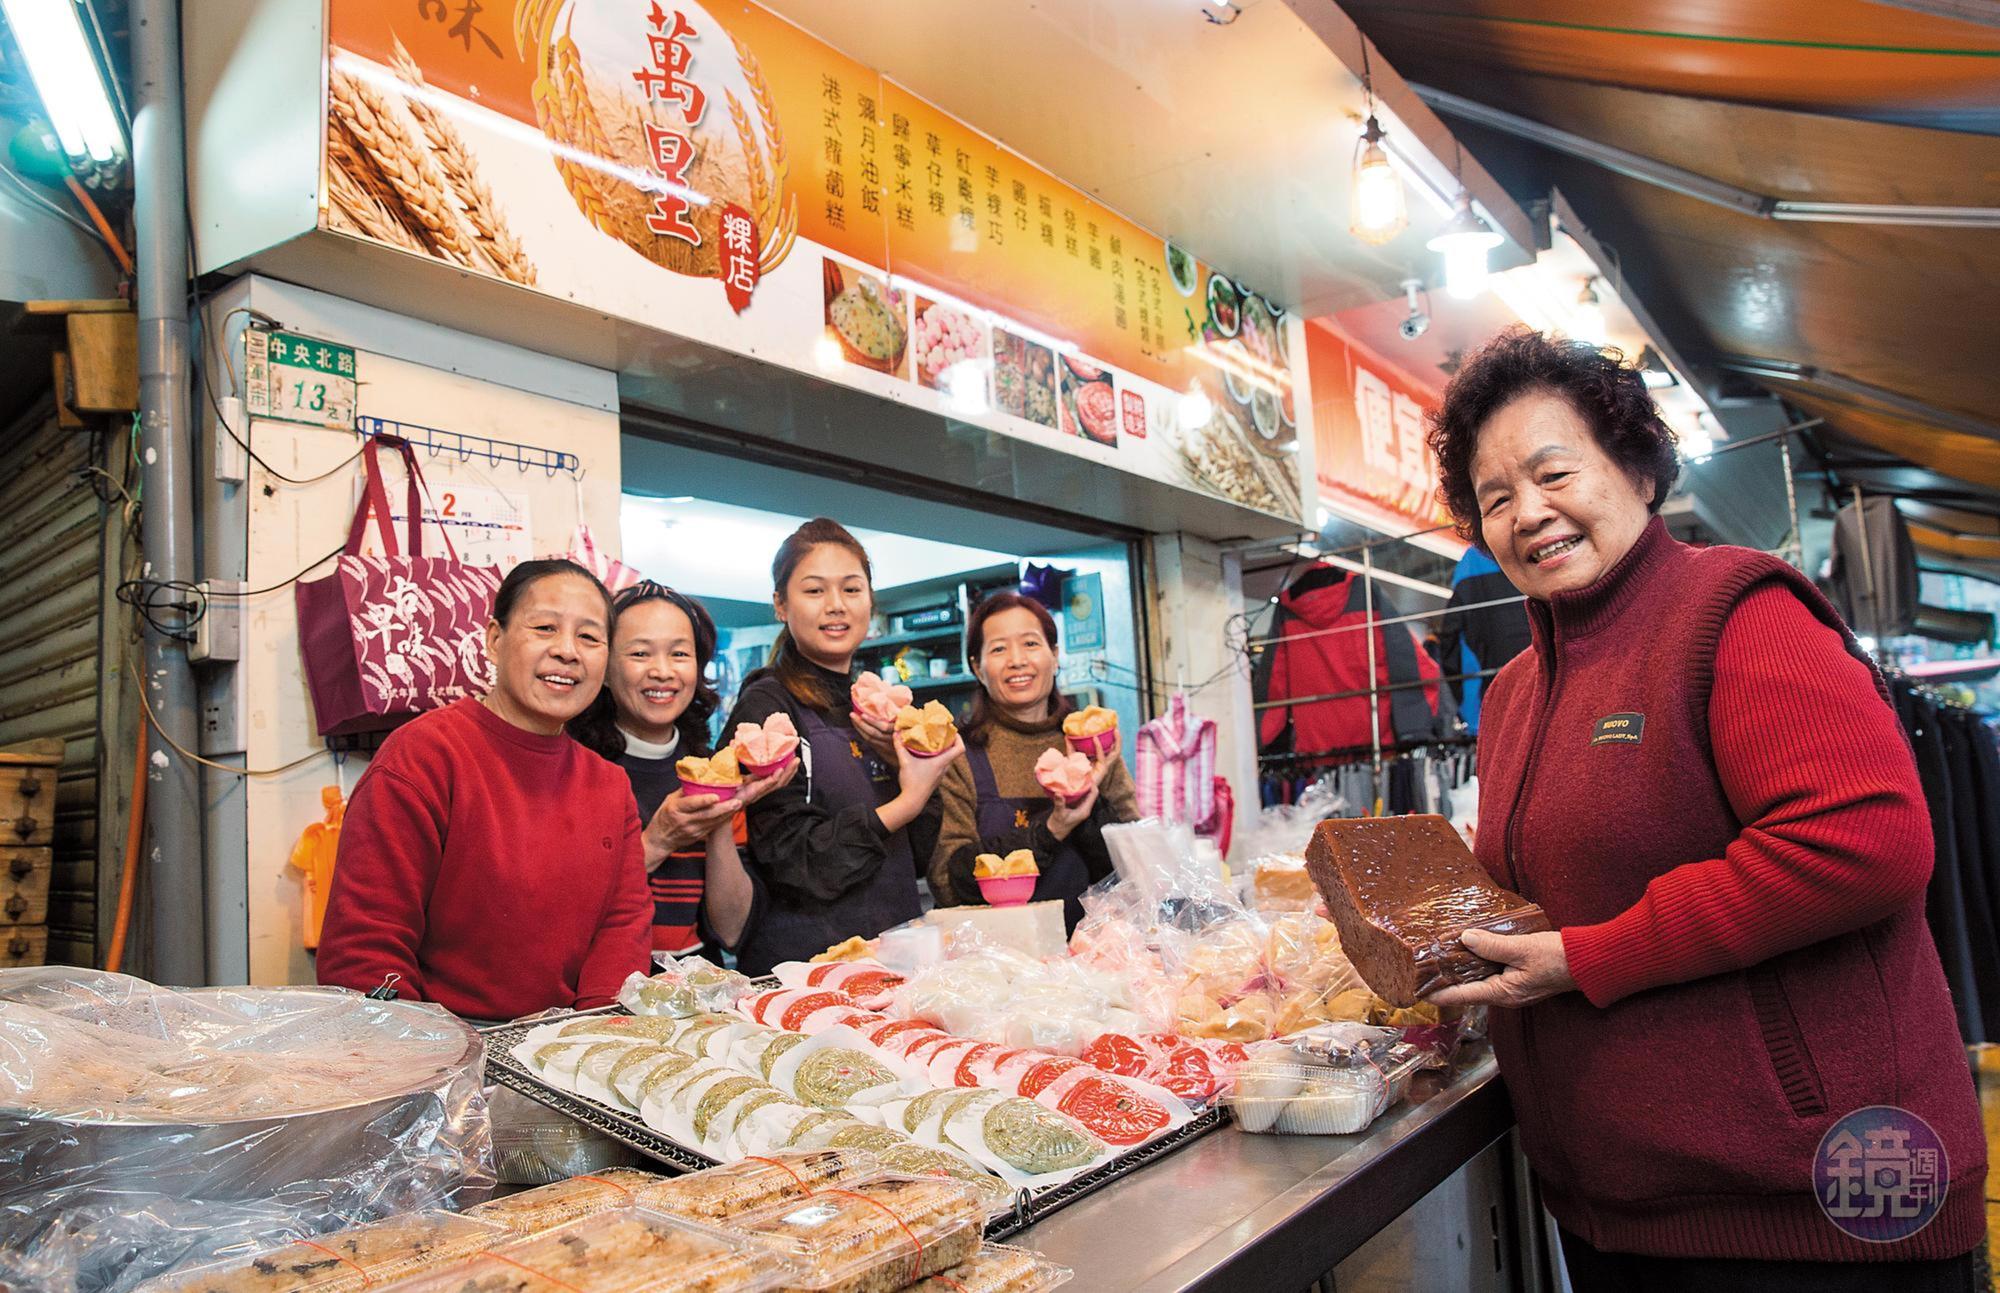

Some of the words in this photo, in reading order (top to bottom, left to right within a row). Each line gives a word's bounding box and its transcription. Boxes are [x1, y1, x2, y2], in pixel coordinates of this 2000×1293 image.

[632, 0, 706, 246] 萬里
[822, 73, 846, 232] 港式蘿蔔糕
[857, 93, 880, 216] 彌月油飯
[925, 131, 945, 217] 草仔粿
[722, 214, 754, 292] 粿店
[270, 337, 354, 375] 中央北路
[442, 493, 456, 517] 2
